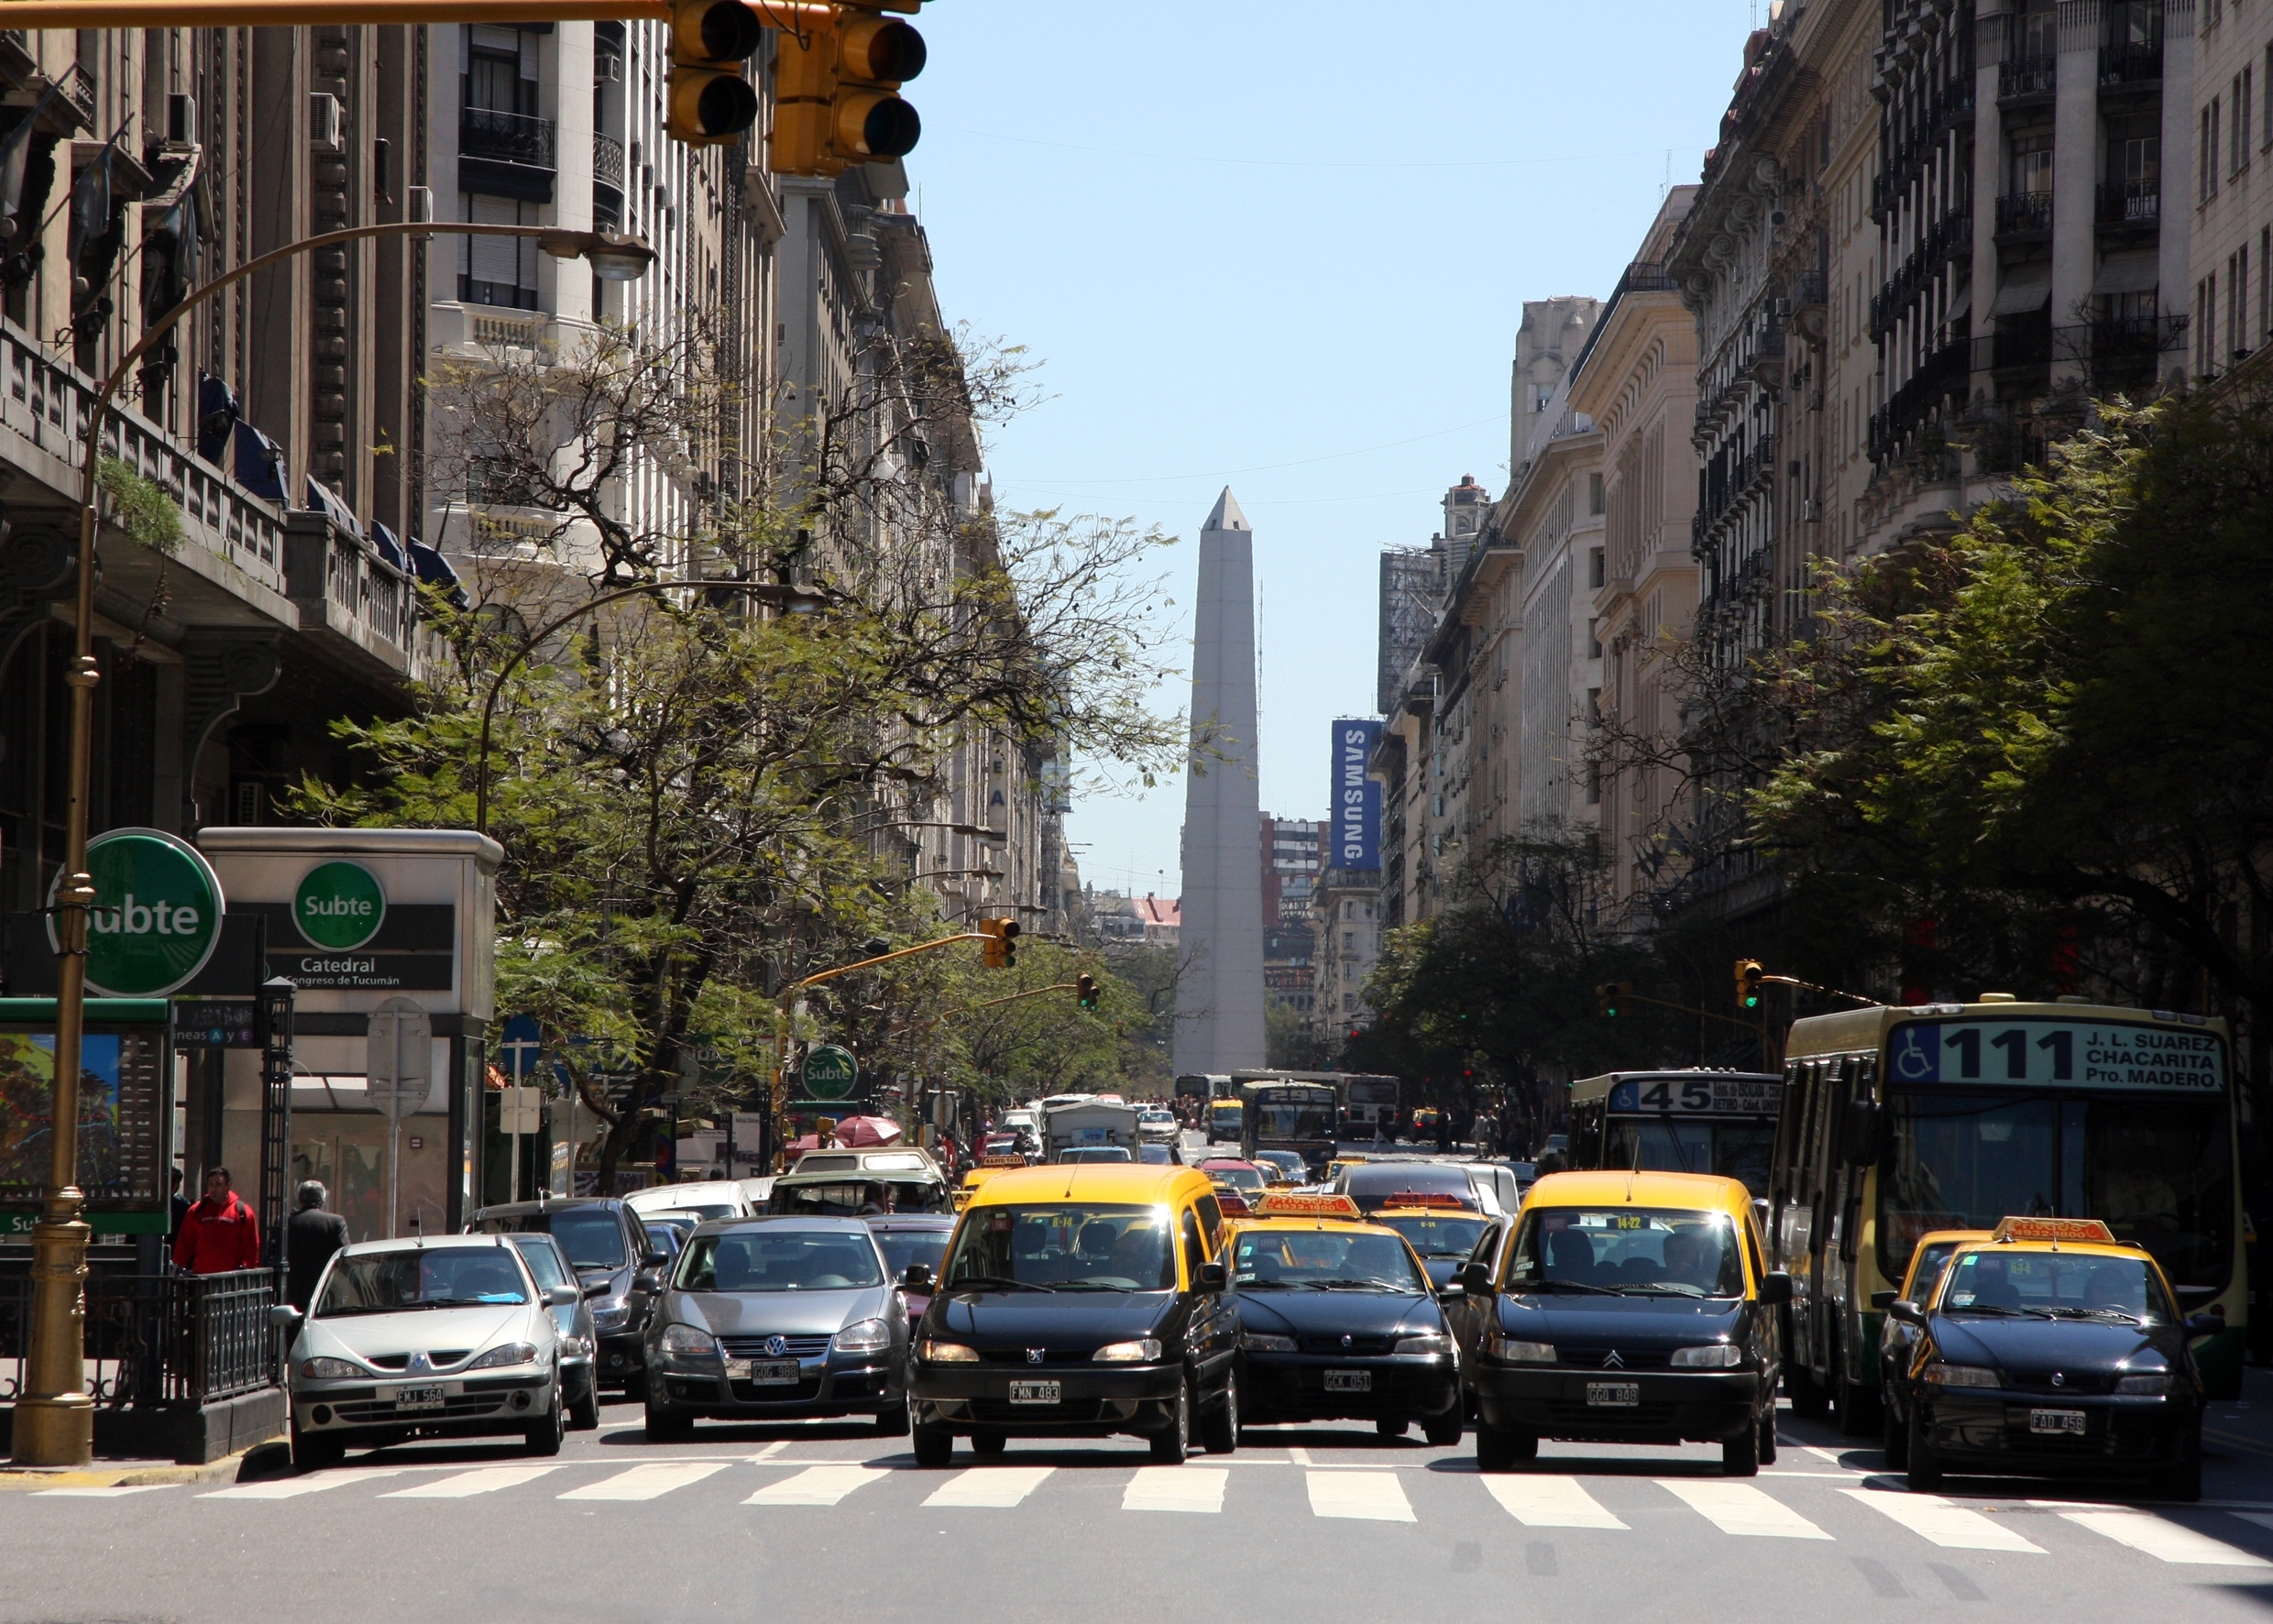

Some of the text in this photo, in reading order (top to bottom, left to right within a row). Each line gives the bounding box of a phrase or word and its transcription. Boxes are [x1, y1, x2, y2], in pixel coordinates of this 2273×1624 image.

[1345, 730, 1366, 860] SAMSUNG
[305, 894, 372, 916] Subte
[85, 894, 199, 935] ubte
[301, 957, 375, 973] Catedral
[286, 975, 400, 987] Congreso de Tucumán
[226, 1032, 235, 1043] y
[1944, 1028, 2215, 1081] 111 J. L. SUAREZ
[2086, 1049, 2214, 1070] CHACARITA
[2127, 1070, 2215, 1089] MADERO
[1641, 1081, 1711, 1110] 45
[1713, 1099, 1738, 1111] RETIRO
[778, 1366, 796, 1377] 988
[1326, 1376, 1368, 1388] GCK 051
[398, 1388, 442, 1403] EMJ 564
[1012, 1387, 1059, 1399] FMN 483
[1616, 1388, 1637, 1401] 848
[2033, 1414, 2083, 1430] FAD 458
